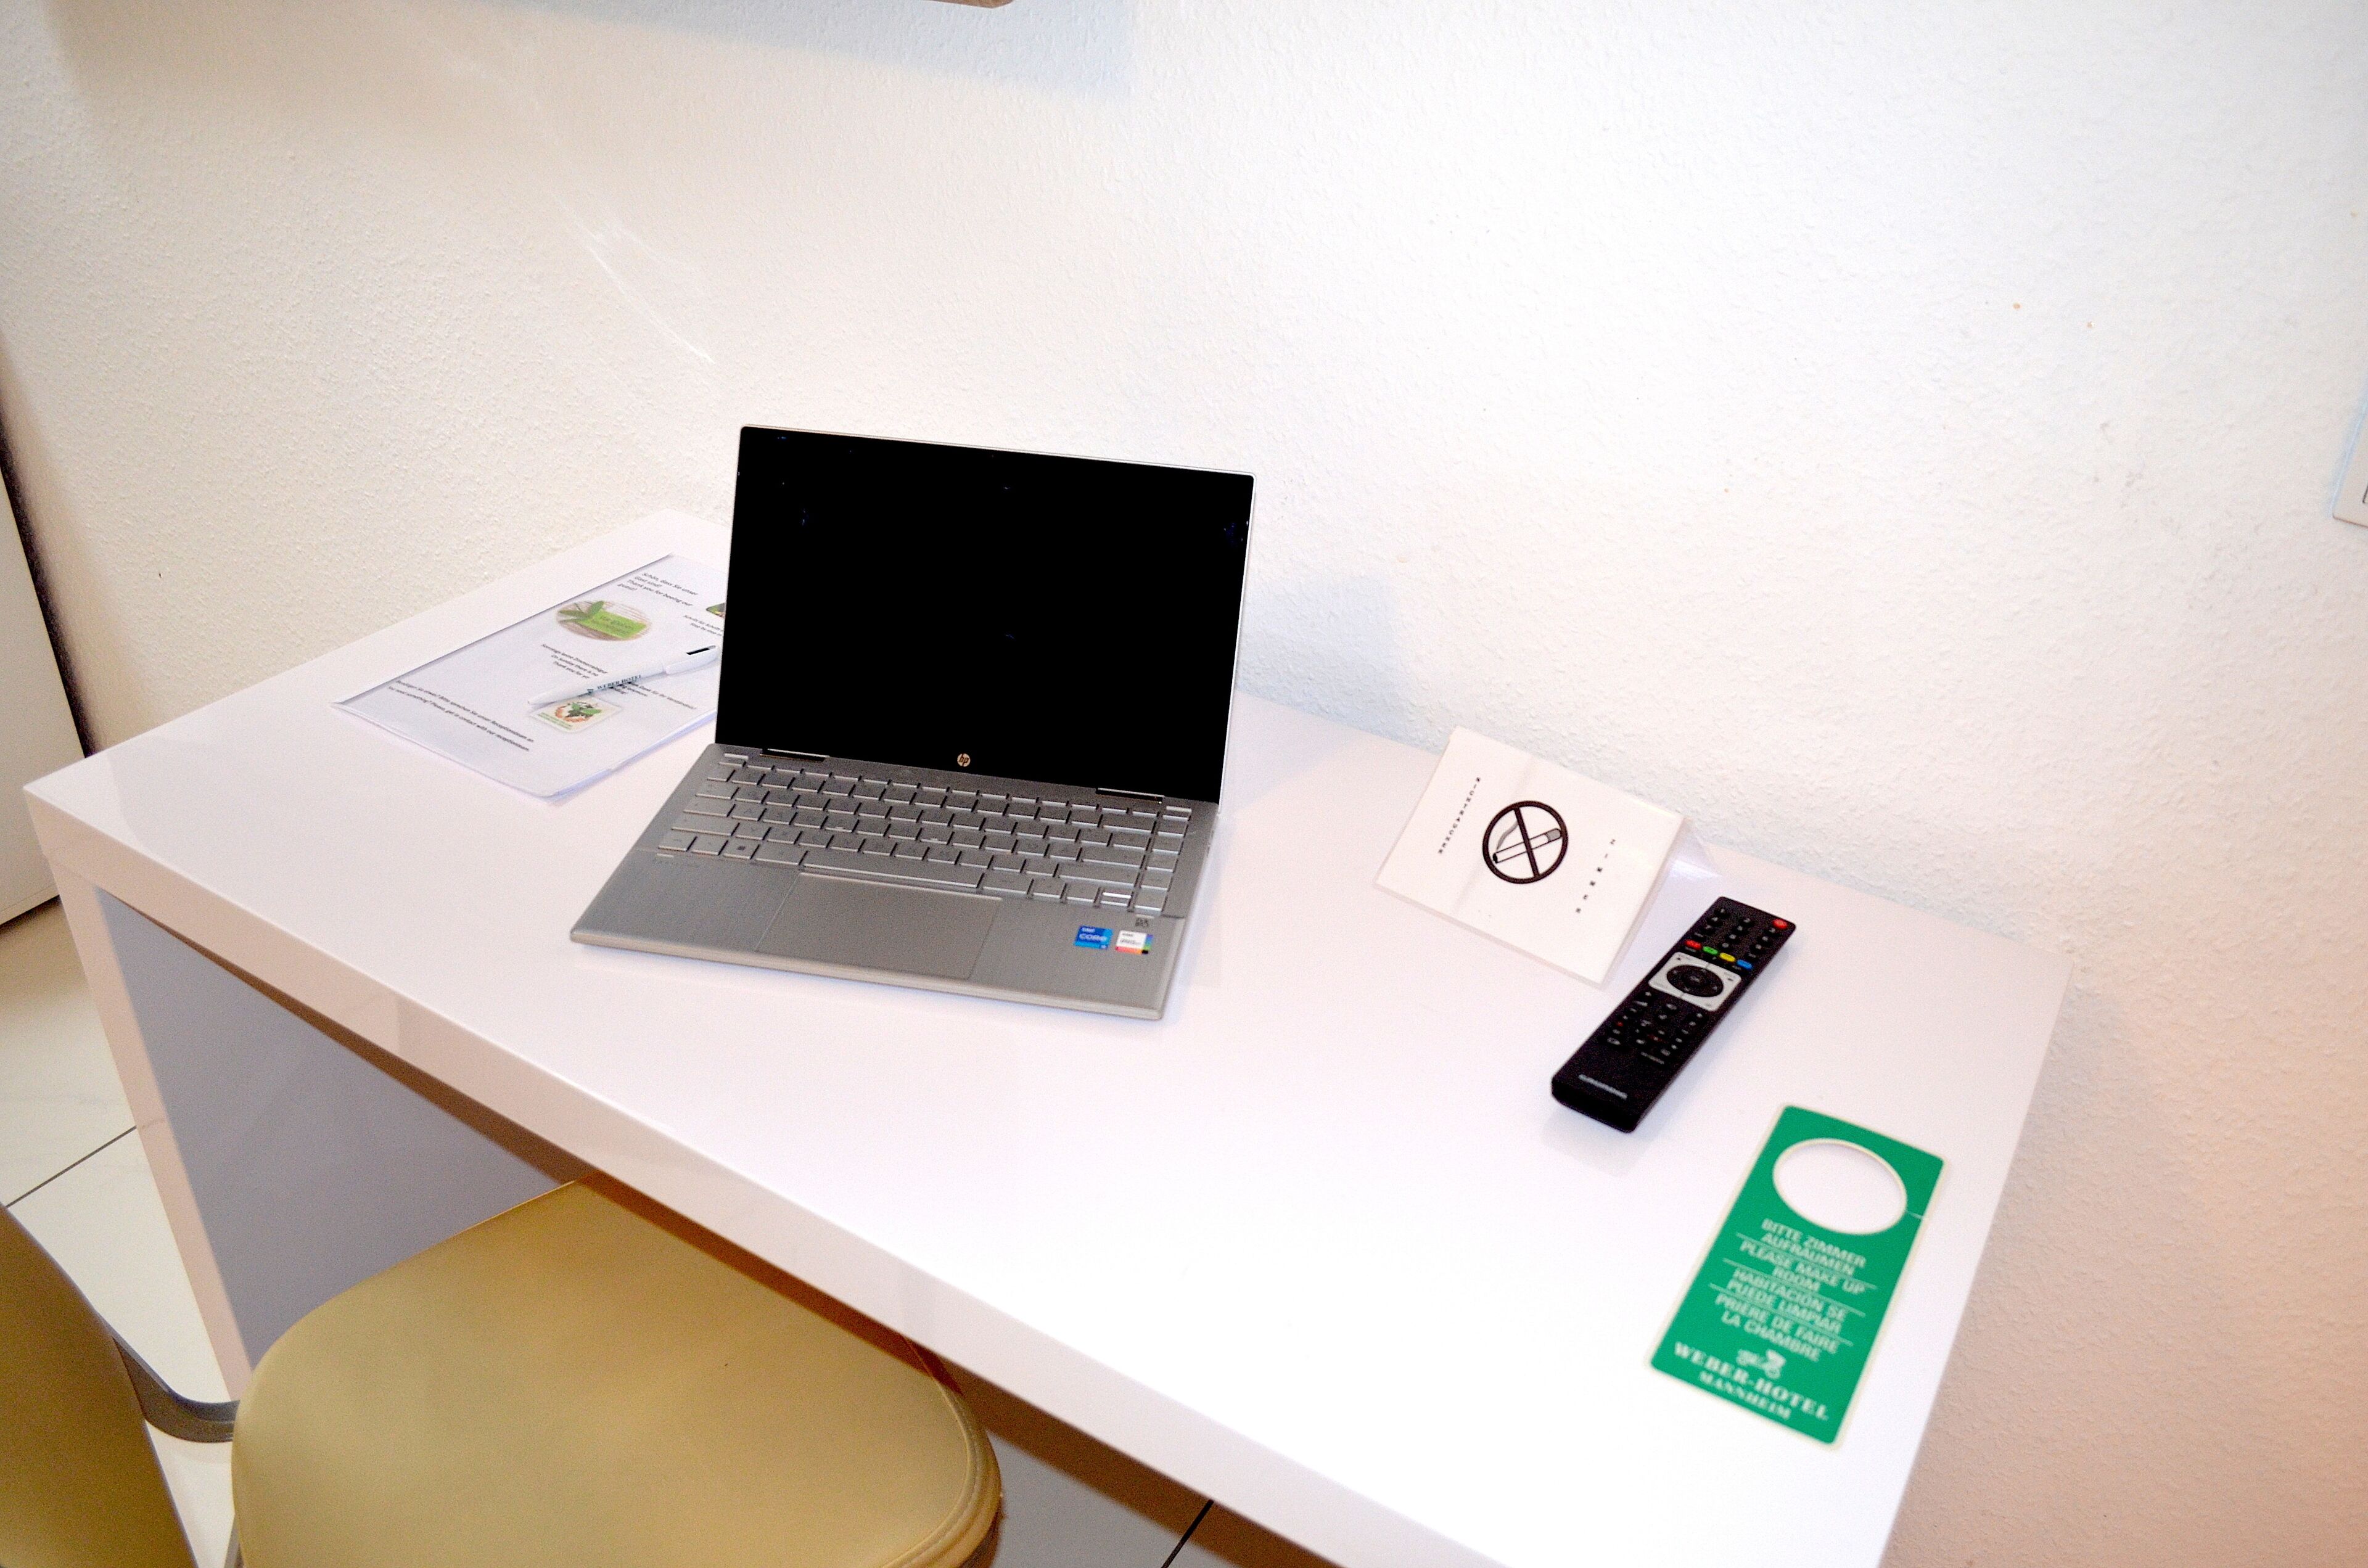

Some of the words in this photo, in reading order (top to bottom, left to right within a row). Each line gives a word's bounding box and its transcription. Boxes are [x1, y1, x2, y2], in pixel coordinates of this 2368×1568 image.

[627, 580, 643, 589] Thank
[598, 681, 619, 689] WEBER
[621, 675, 641, 684] HOTEL
[957, 753, 971, 766] hp
[1437, 776, 1481, 854] NICHTRAUCHER
[1740, 1240, 1792, 1268] PLEASE
[1795, 1262, 1840, 1287] MAKE
[1841, 1278, 1866, 1294] UP
[1761, 1218, 1803, 1242] BITTE
[1803, 1235, 1867, 1268] ZIMMER
[1772, 1265, 1821, 1292] ROOM
[1727, 1279, 1776, 1309] PUEDE
[1777, 1299, 1842, 1334] LIMPIAR
[1827, 1305, 1847, 1321] SE
[1722, 1311, 1741, 1328] LA
[1744, 1319, 1822, 1361] CHAMBRE
[1772, 1316, 1793, 1332] DE
[1795, 1326, 1840, 1354] FAIRE
[1675, 1340, 1830, 1421] WEBER-HOTEL
[1699, 1370, 1791, 1421] MANNHEIM
